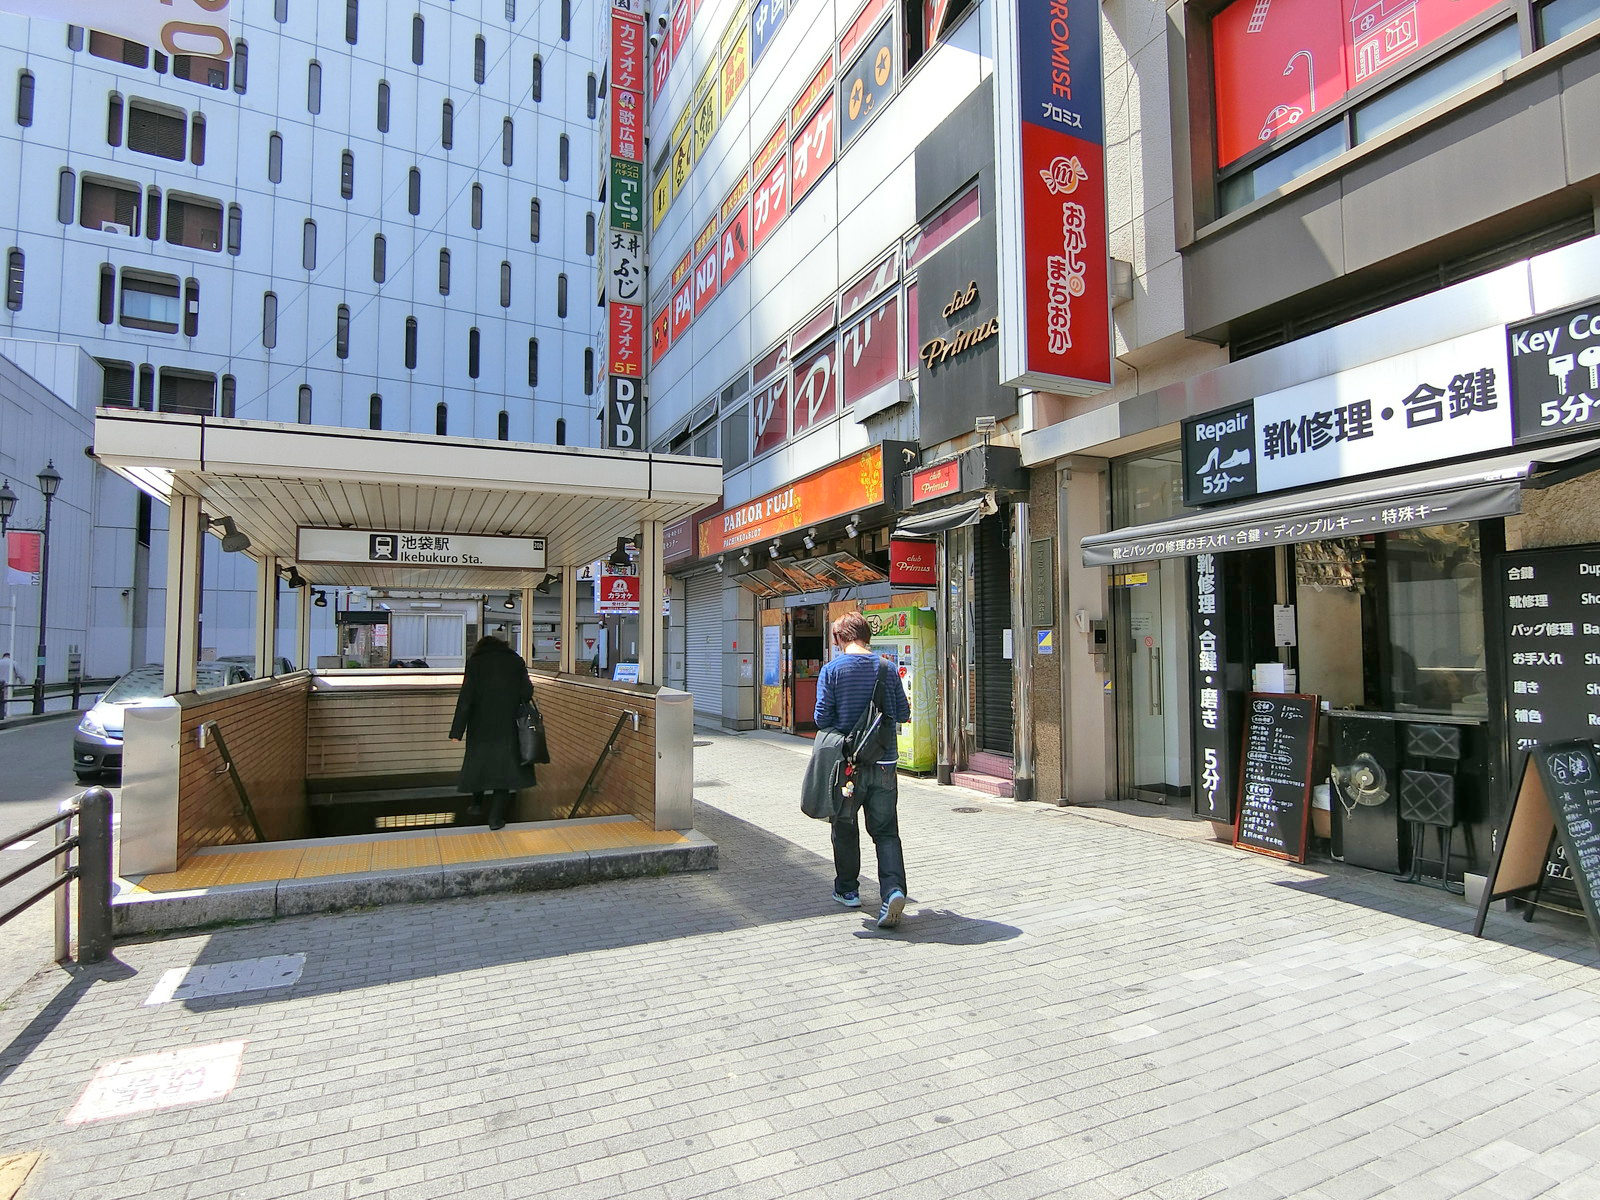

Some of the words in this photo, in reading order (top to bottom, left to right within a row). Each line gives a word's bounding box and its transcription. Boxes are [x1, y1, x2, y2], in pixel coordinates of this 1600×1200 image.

[620, 24, 636, 88] カラオケ
[1042, 102, 1083, 129] プロミス
[619, 109, 636, 159] 歌広場
[615, 162, 639, 172] パチンコ
[615, 169, 639, 179] パチスロ
[614, 178, 638, 222] Fuji
[675, 231, 735, 326] PANDA
[754, 110, 833, 232] カラオケ
[1065, 205, 1085, 296] おかしの
[613, 258, 640, 299] ふじ
[942, 280, 978, 319] club
[1050, 259, 1071, 351] まちおか
[619, 305, 634, 361] カラオケ
[919, 316, 1000, 369] Primus
[1511, 327, 1560, 357] Key
[614, 362, 637, 374] 5F
[616, 378, 635, 447] DVD
[1263, 367, 1498, 460] 靴修理・合鍵
[1195, 412, 1249, 442] Repair
[921, 479, 950, 494] Primus
[929, 471, 942, 481] club
[723, 502, 763, 533] PARLOR
[766, 488, 794, 517] FUJI
[401, 535, 450, 552] 池袋駅
[400, 551, 458, 564] Ikebukuro
[462, 553, 484, 565] Sta.
[896, 561, 931, 573] Primus
[907, 555, 922, 563] club
[1507, 566, 1535, 581] 合鍵
[608, 592, 633, 600] カラオケ
[1508, 594, 1549, 609] 靴修理
[1511, 622, 1574, 637] バッグ修理
[1512, 652, 1563, 665] お手入れ
[1513, 680, 1539, 694] 磨き
[1514, 709, 1542, 724] 補色
